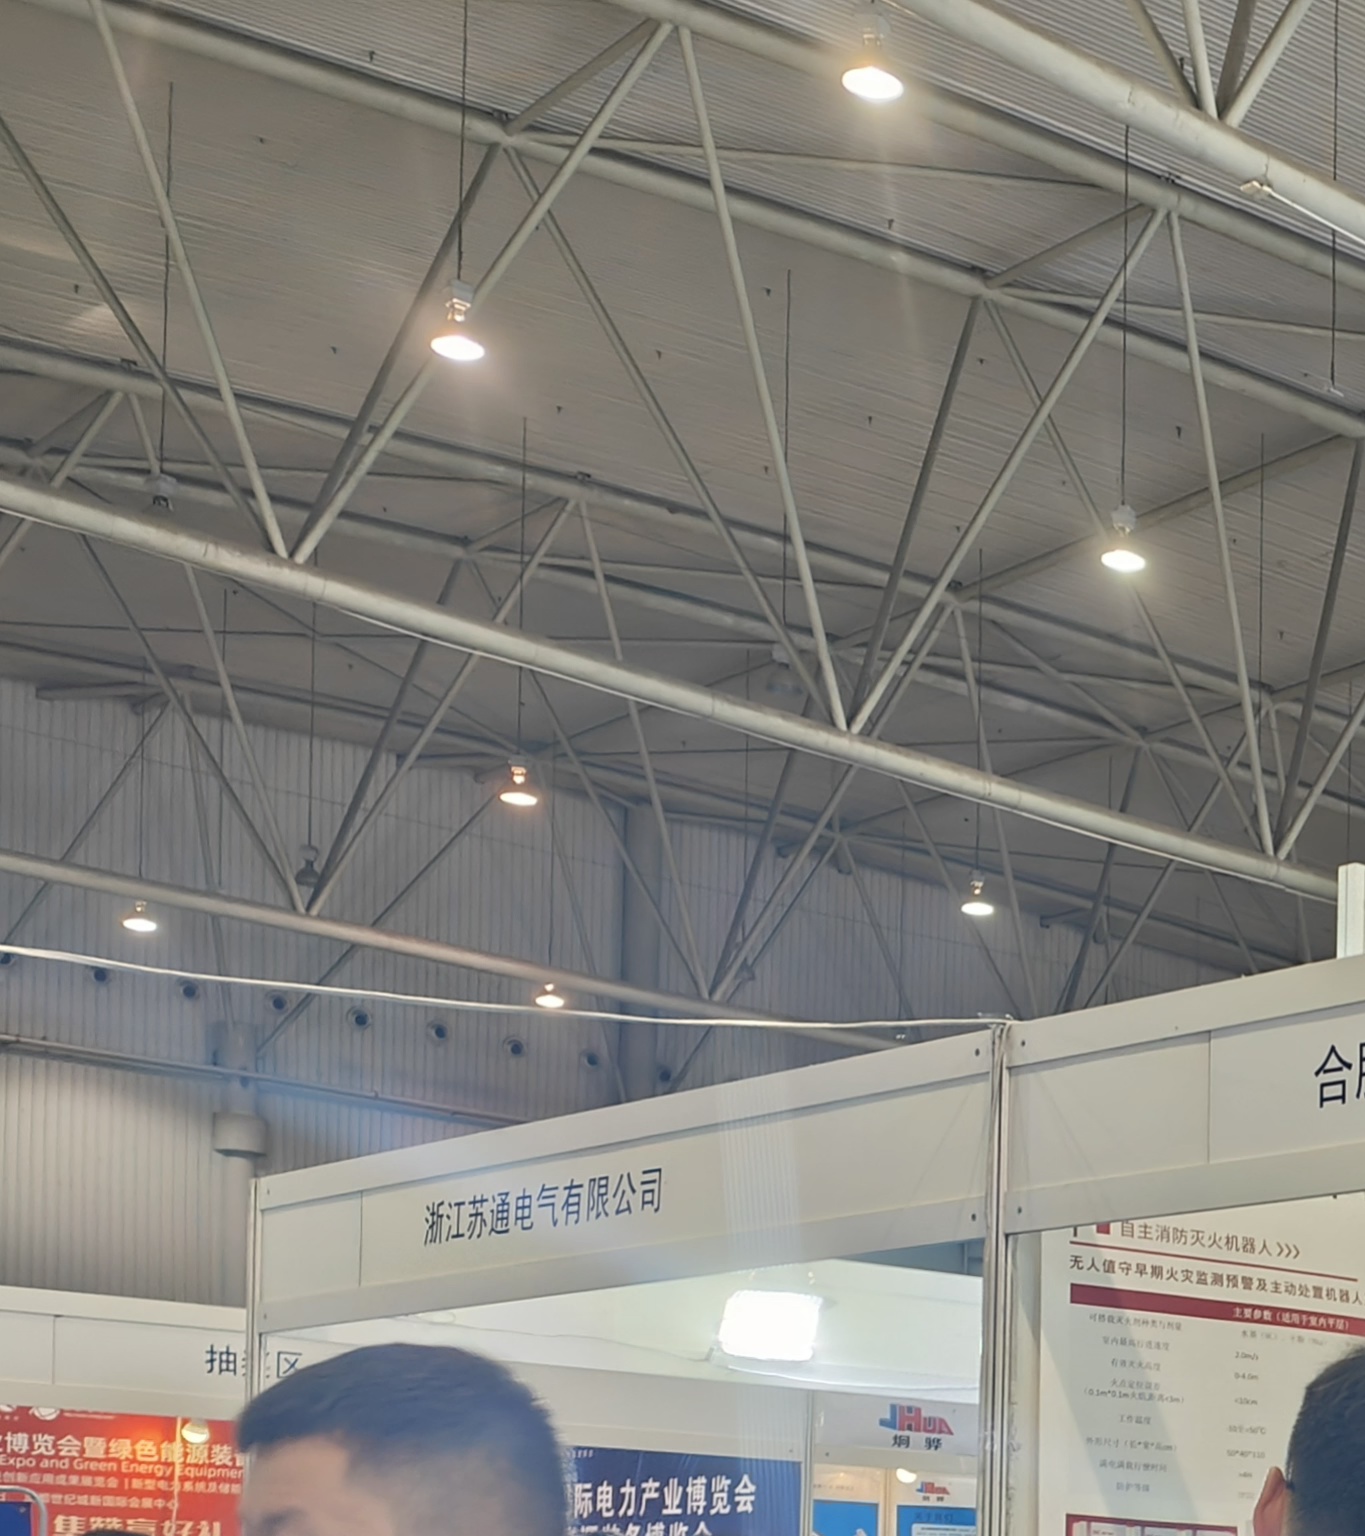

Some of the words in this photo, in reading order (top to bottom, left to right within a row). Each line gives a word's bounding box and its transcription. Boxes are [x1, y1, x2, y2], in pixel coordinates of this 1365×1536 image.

[424, 1168, 662, 1246] 浙江苏通电气有限公司
[1121, 1221, 1272, 1257] 自主消防灭火机器人
[205, 1344, 303, 1379] 抽区
[0, 1431, 243, 1467] 博览会暨绿色能源装
[40, 1457, 69, 1470] and
[74, 1459, 117, 1473] Green
[121, 1461, 172, 1478] Energy
[573, 1474, 757, 1519] 际电力产业博览会
